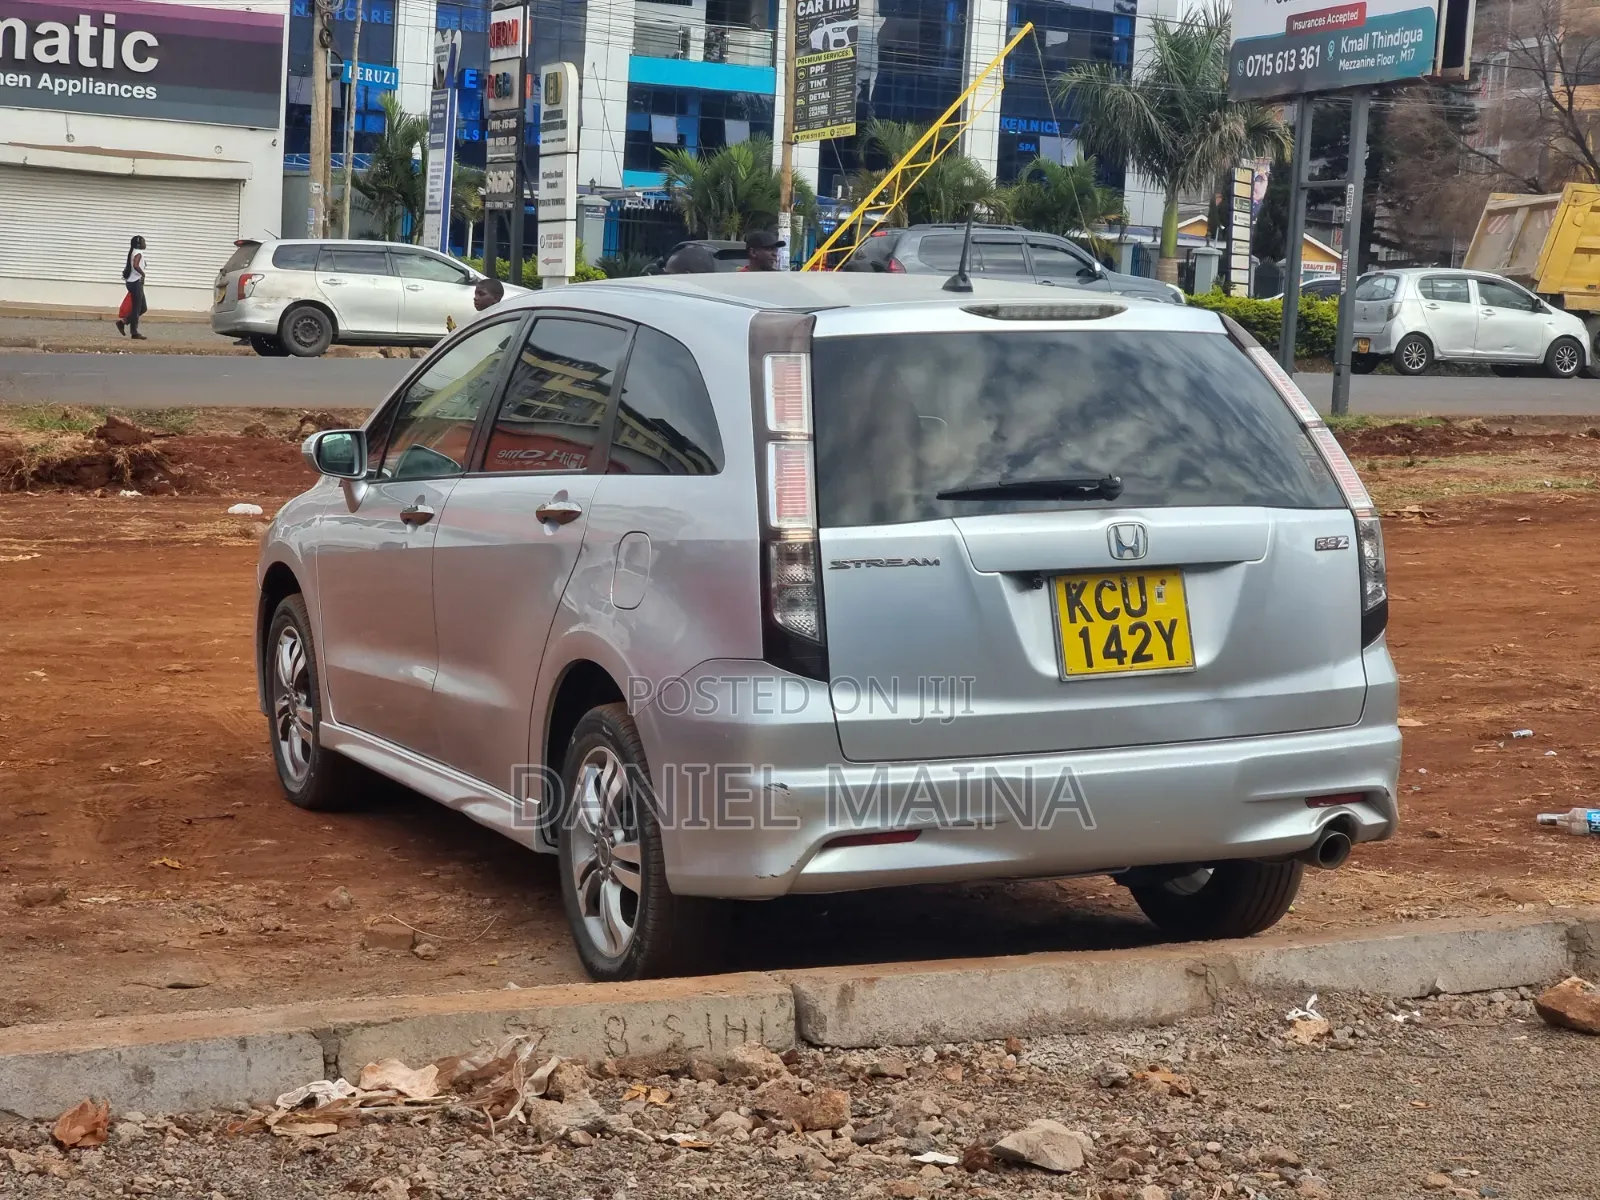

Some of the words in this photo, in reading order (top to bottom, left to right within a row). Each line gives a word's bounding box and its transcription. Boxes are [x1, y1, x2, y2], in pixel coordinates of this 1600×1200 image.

[797, 0, 823, 16] CAR
[1293, 17, 1325, 30] Insurances
[1326, 11, 1358, 24] Accepted
[1340, 33, 1369, 53] Kmall
[1372, 26, 1423, 49] Thindigua
[797, 54, 822, 65] PREMIUM
[1246, 53, 1273, 77] 0715
[1275, 49, 1296, 74] 613
[1299, 45, 1320, 70] 361
[1338, 55, 1375, 71] Mezzanine
[1400, 48, 1415, 62] M17
[810, 64, 826, 75] PPF
[37, 72, 157, 100] Appliances
[809, 78, 827, 88] TINT
[809, 91, 830, 101] DETAIL
[1019, 143, 1036, 152] SPA
[828, 556, 940, 570] STREAM
[1065, 576, 1148, 624] KCU
[1079, 618, 1178, 668] 142Y
